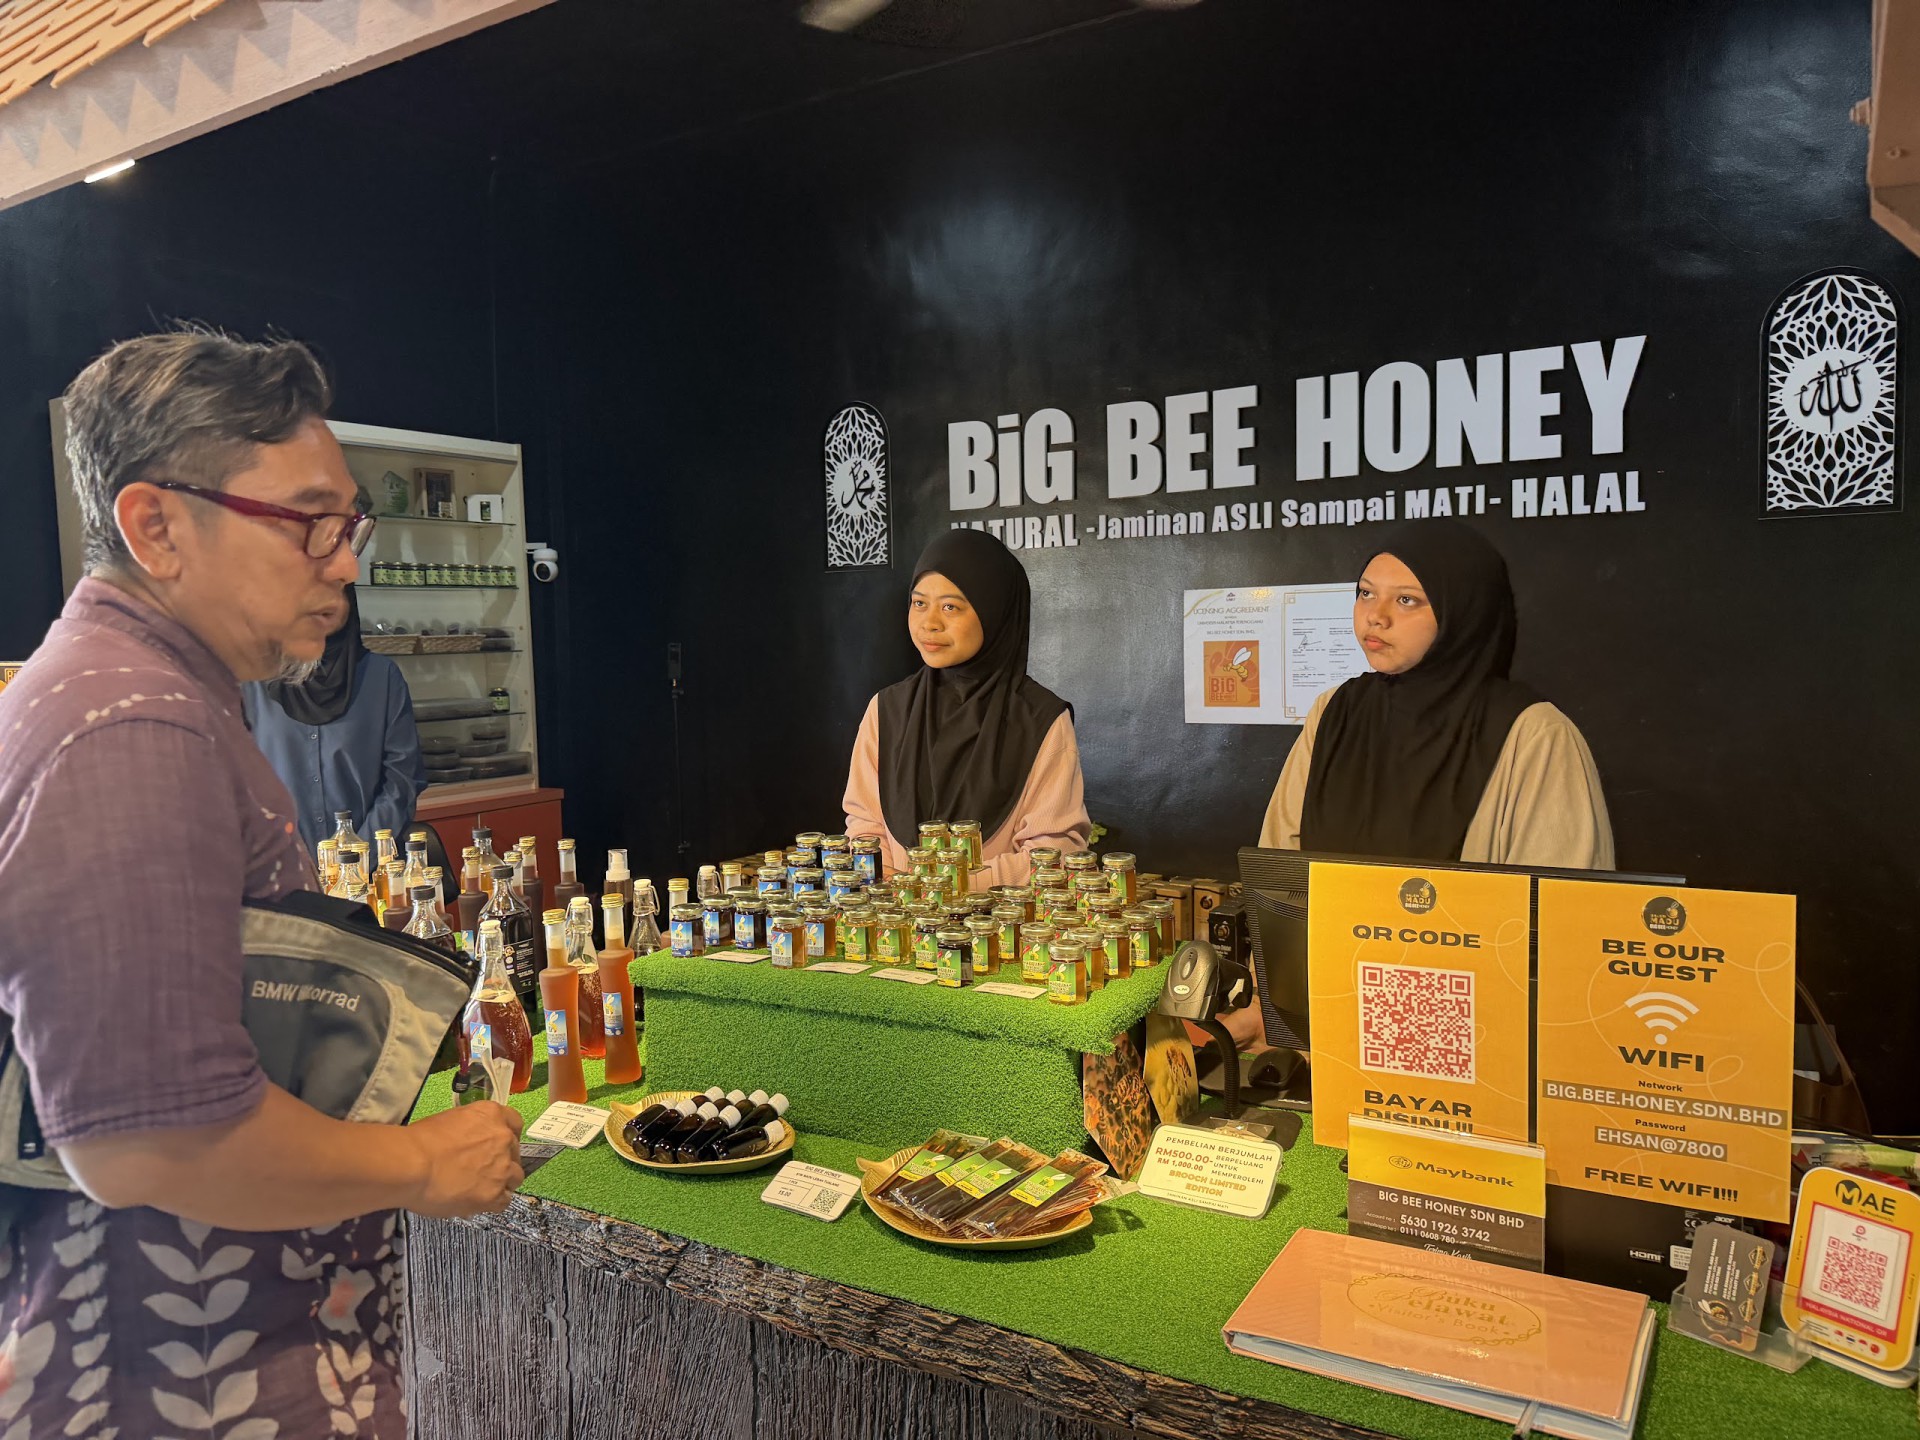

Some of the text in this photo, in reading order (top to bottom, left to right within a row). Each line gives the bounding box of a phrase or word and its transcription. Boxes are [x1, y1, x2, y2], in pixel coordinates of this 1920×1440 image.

[948, 335, 1647, 511] BiG BEE HONEY
[951, 514, 1079, 550] TURAL
[1212, 503, 1273, 533] ASLI
[1281, 491, 1395, 527] Sampai
[1512, 471, 1646, 518] HALAL
[1226, 606, 1270, 614] AGGREEMENT
[1353, 925, 1481, 948] QR CODE
[1602, 939, 1725, 963] BE OUR
[1608, 960, 1717, 983] GUEST
[252, 980, 299, 1001] BMW
[1618, 1046, 1704, 1072] WIFI
[1638, 1080, 1683, 1092] Network
[1365, 1090, 1472, 1118] BAYAR
[1547, 1083, 1783, 1127] BIG.BEE.HONEY.SDN.BHD
[1635, 1119, 1686, 1132] Password
[1166, 1136, 1273, 1162] PEMBELIAN BERJUMLAH
[1597, 1128, 1725, 1159] EHSAN@7800
[1157, 1157, 1204, 1171] RM 1,000.00
[1214, 1162, 1239, 1171] UNTUK
[1216, 1155, 1264, 1169] BERPELUANG
[1169, 1169, 1247, 1191] BROOCH LIMITED
[1415, 1162, 1515, 1187] Maybank
[1585, 1167, 1739, 1203] FREE WIFI!!!
[1185, 1183, 1223, 1197] EDITION
[1836, 1180, 1897, 1216] MAE
[1378, 1190, 1525, 1229] BIG BEE HONEY SDN BHD
[1400, 1214, 1491, 1242] 5630 1926 3742
[1400, 1227, 1418, 1237] 0111
[1420, 1231, 1439, 1241] 0608
[1411, 1286, 1496, 1312] Buku
[1453, 1318, 1499, 1335] Book
